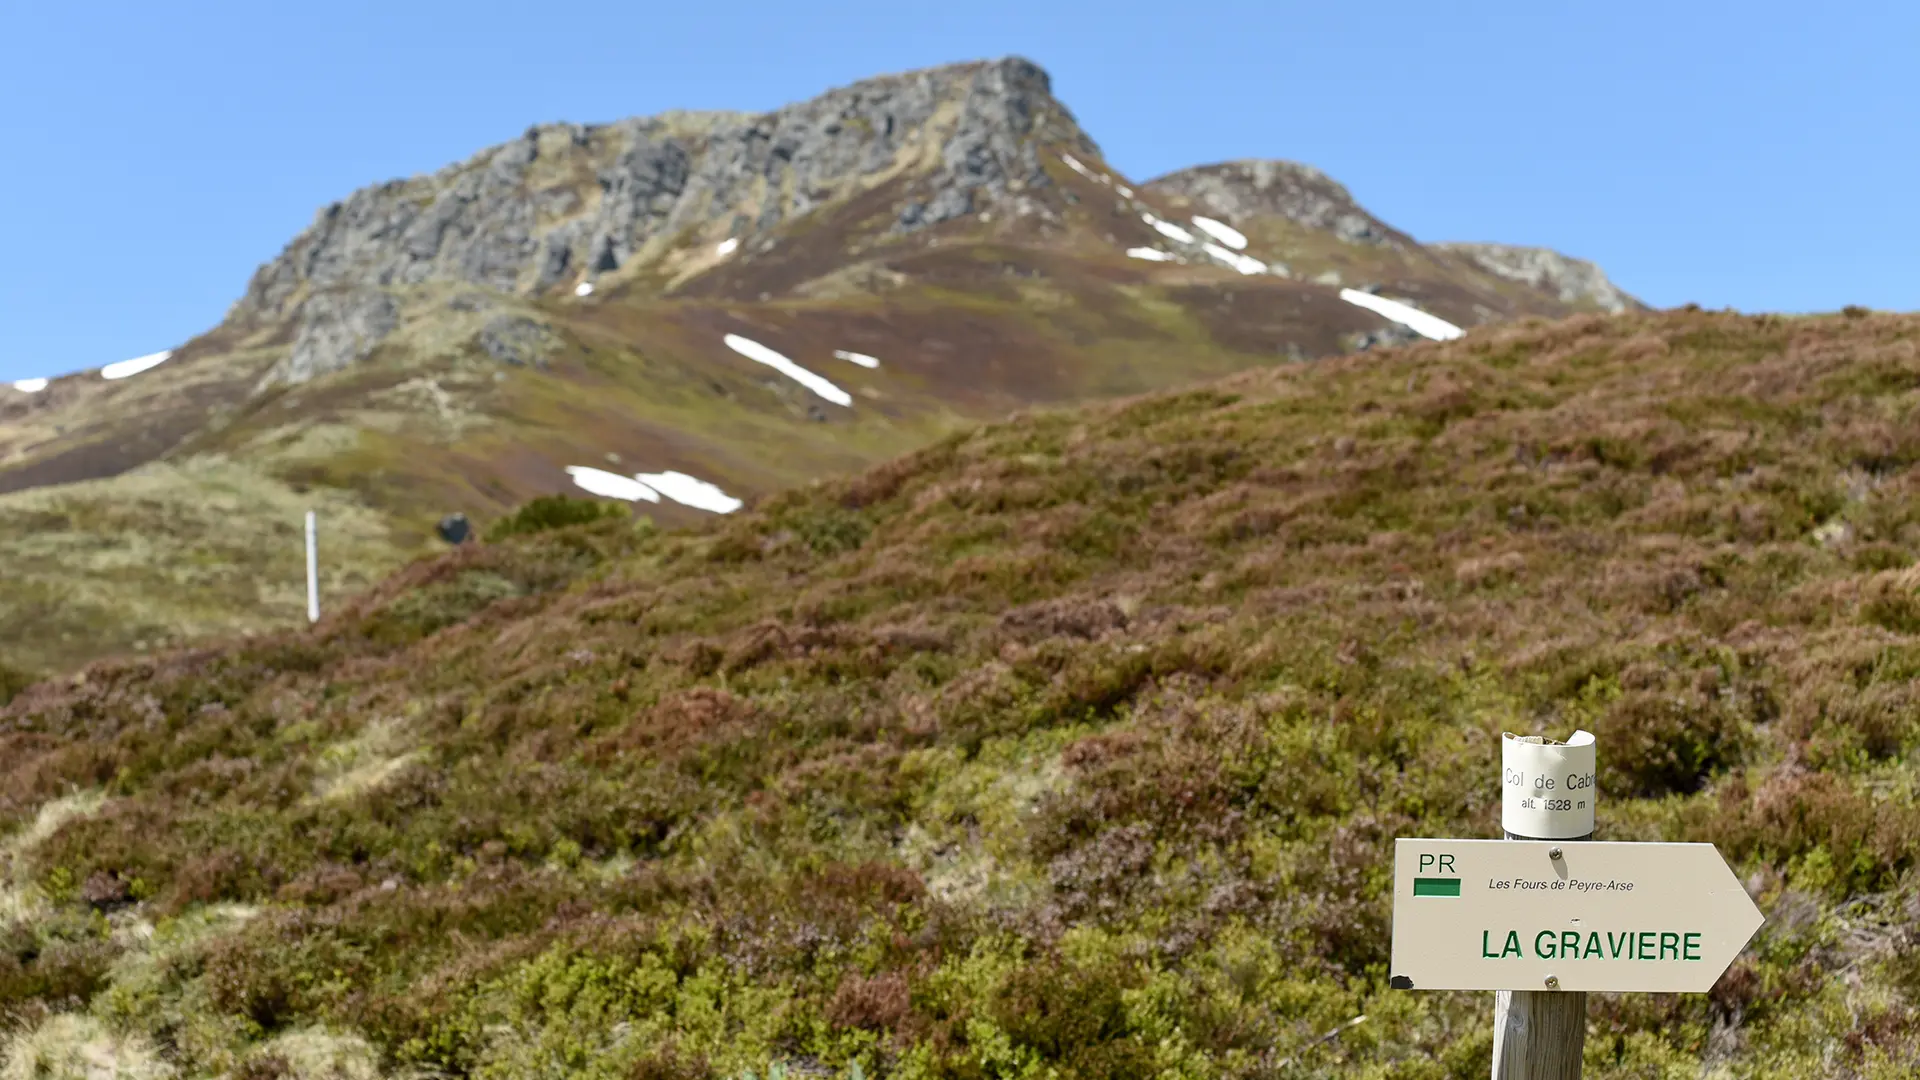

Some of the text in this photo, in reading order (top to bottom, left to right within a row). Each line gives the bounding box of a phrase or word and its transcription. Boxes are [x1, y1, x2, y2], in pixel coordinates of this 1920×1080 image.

[1506, 767, 1524, 787] Col
[1534, 774, 1555, 790] de
[1521, 798, 1586, 811] alt. 1528 m
[1419, 854, 1456, 874] PR
[1488, 878, 1634, 893] Les Fours de Peyre-Arse
[1482, 929, 1703, 961] LA GRAVIERE
